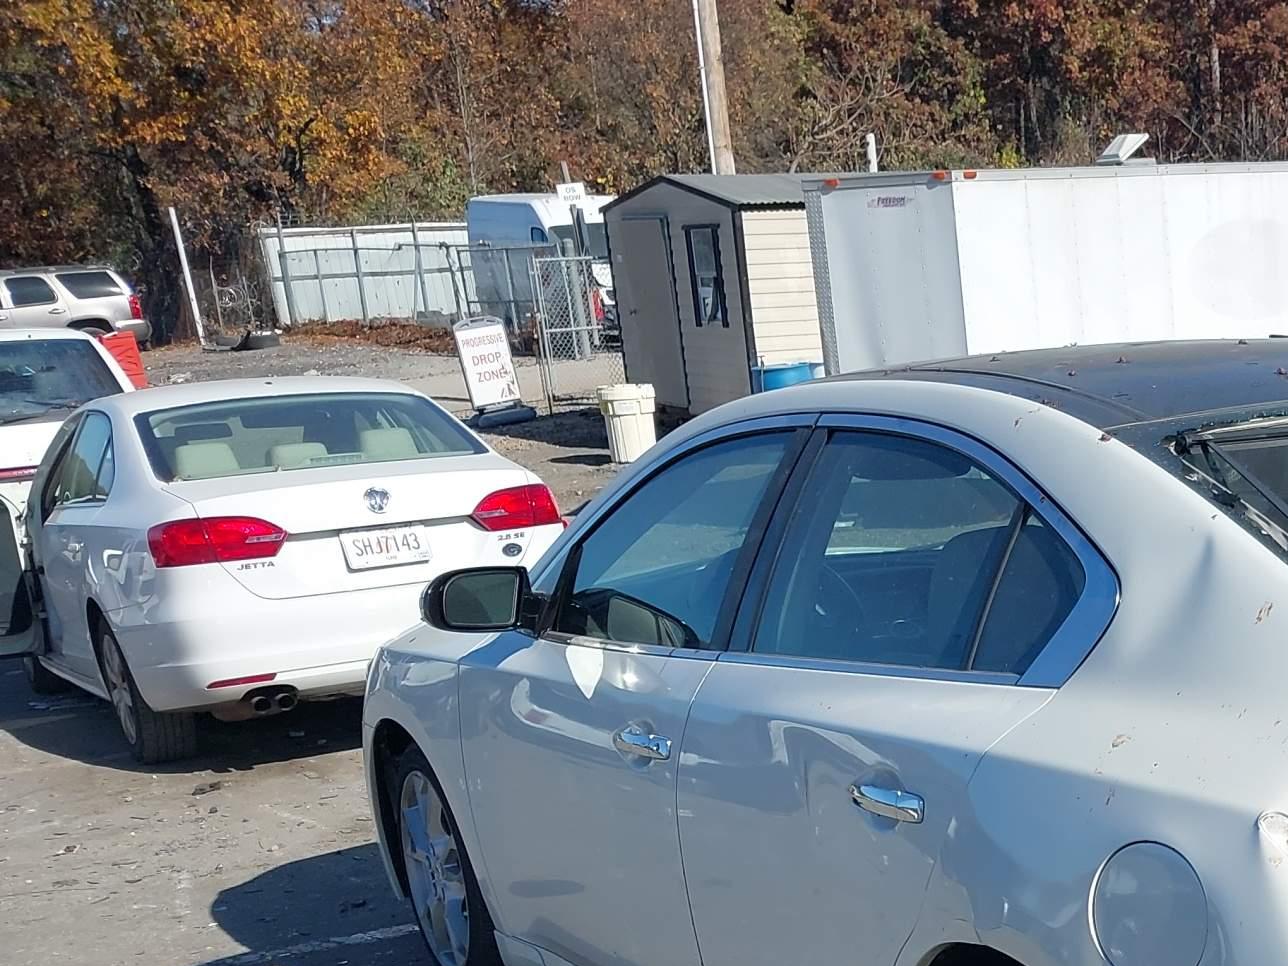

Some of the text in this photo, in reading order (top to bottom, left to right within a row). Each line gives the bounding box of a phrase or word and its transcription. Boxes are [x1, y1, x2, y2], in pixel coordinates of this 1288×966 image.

[461, 333, 505, 349] PROGRESSIVE
[471, 351, 502, 367] DROP
[476, 367, 507, 383] ZONE
[352, 532, 421, 557] SHJ7143
[237, 561, 275, 570] JETTA
